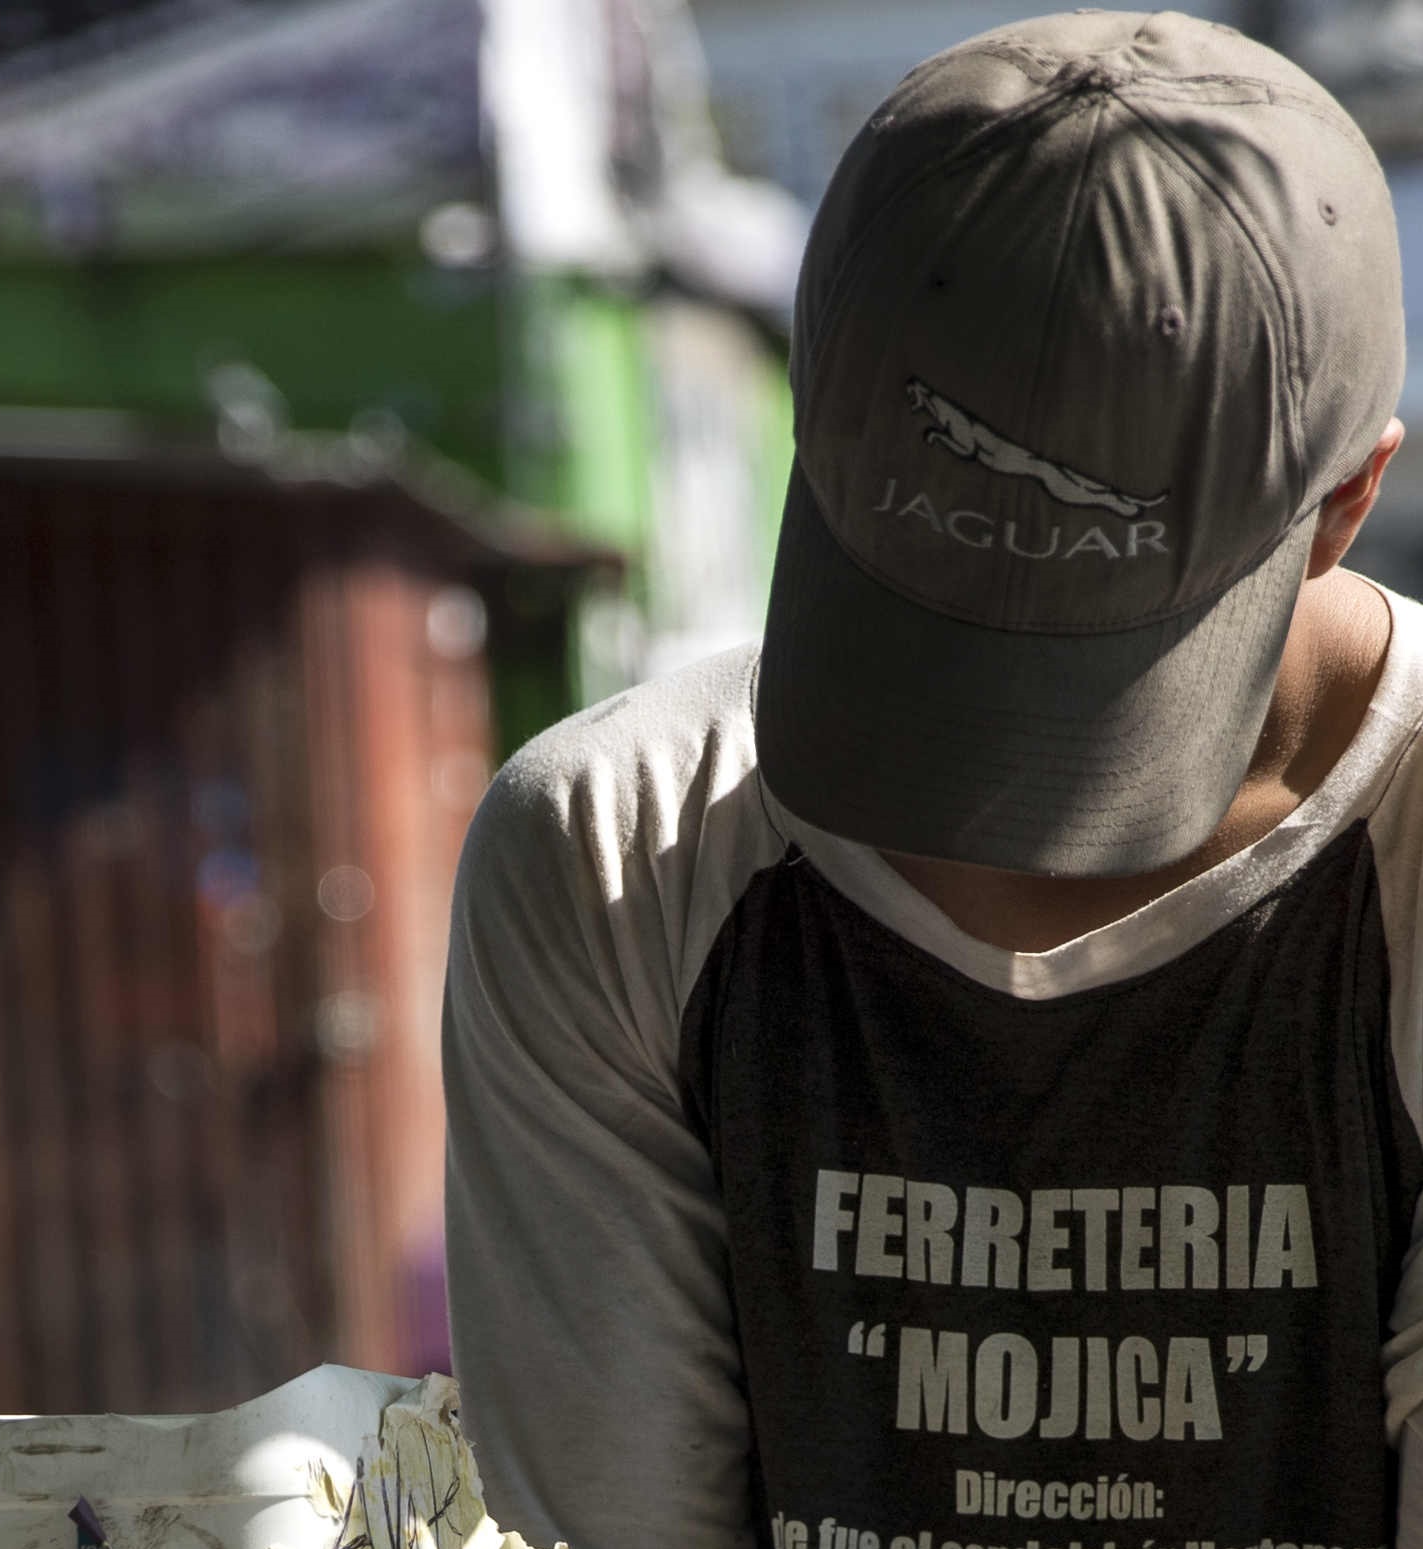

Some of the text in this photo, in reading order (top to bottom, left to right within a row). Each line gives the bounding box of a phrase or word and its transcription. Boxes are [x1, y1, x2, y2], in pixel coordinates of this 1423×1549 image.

[873, 478, 1168, 558] JAGUAR
[812, 1169, 1318, 1292] FERRETERIA
[956, 1469, 1164, 1520] Dirección:
